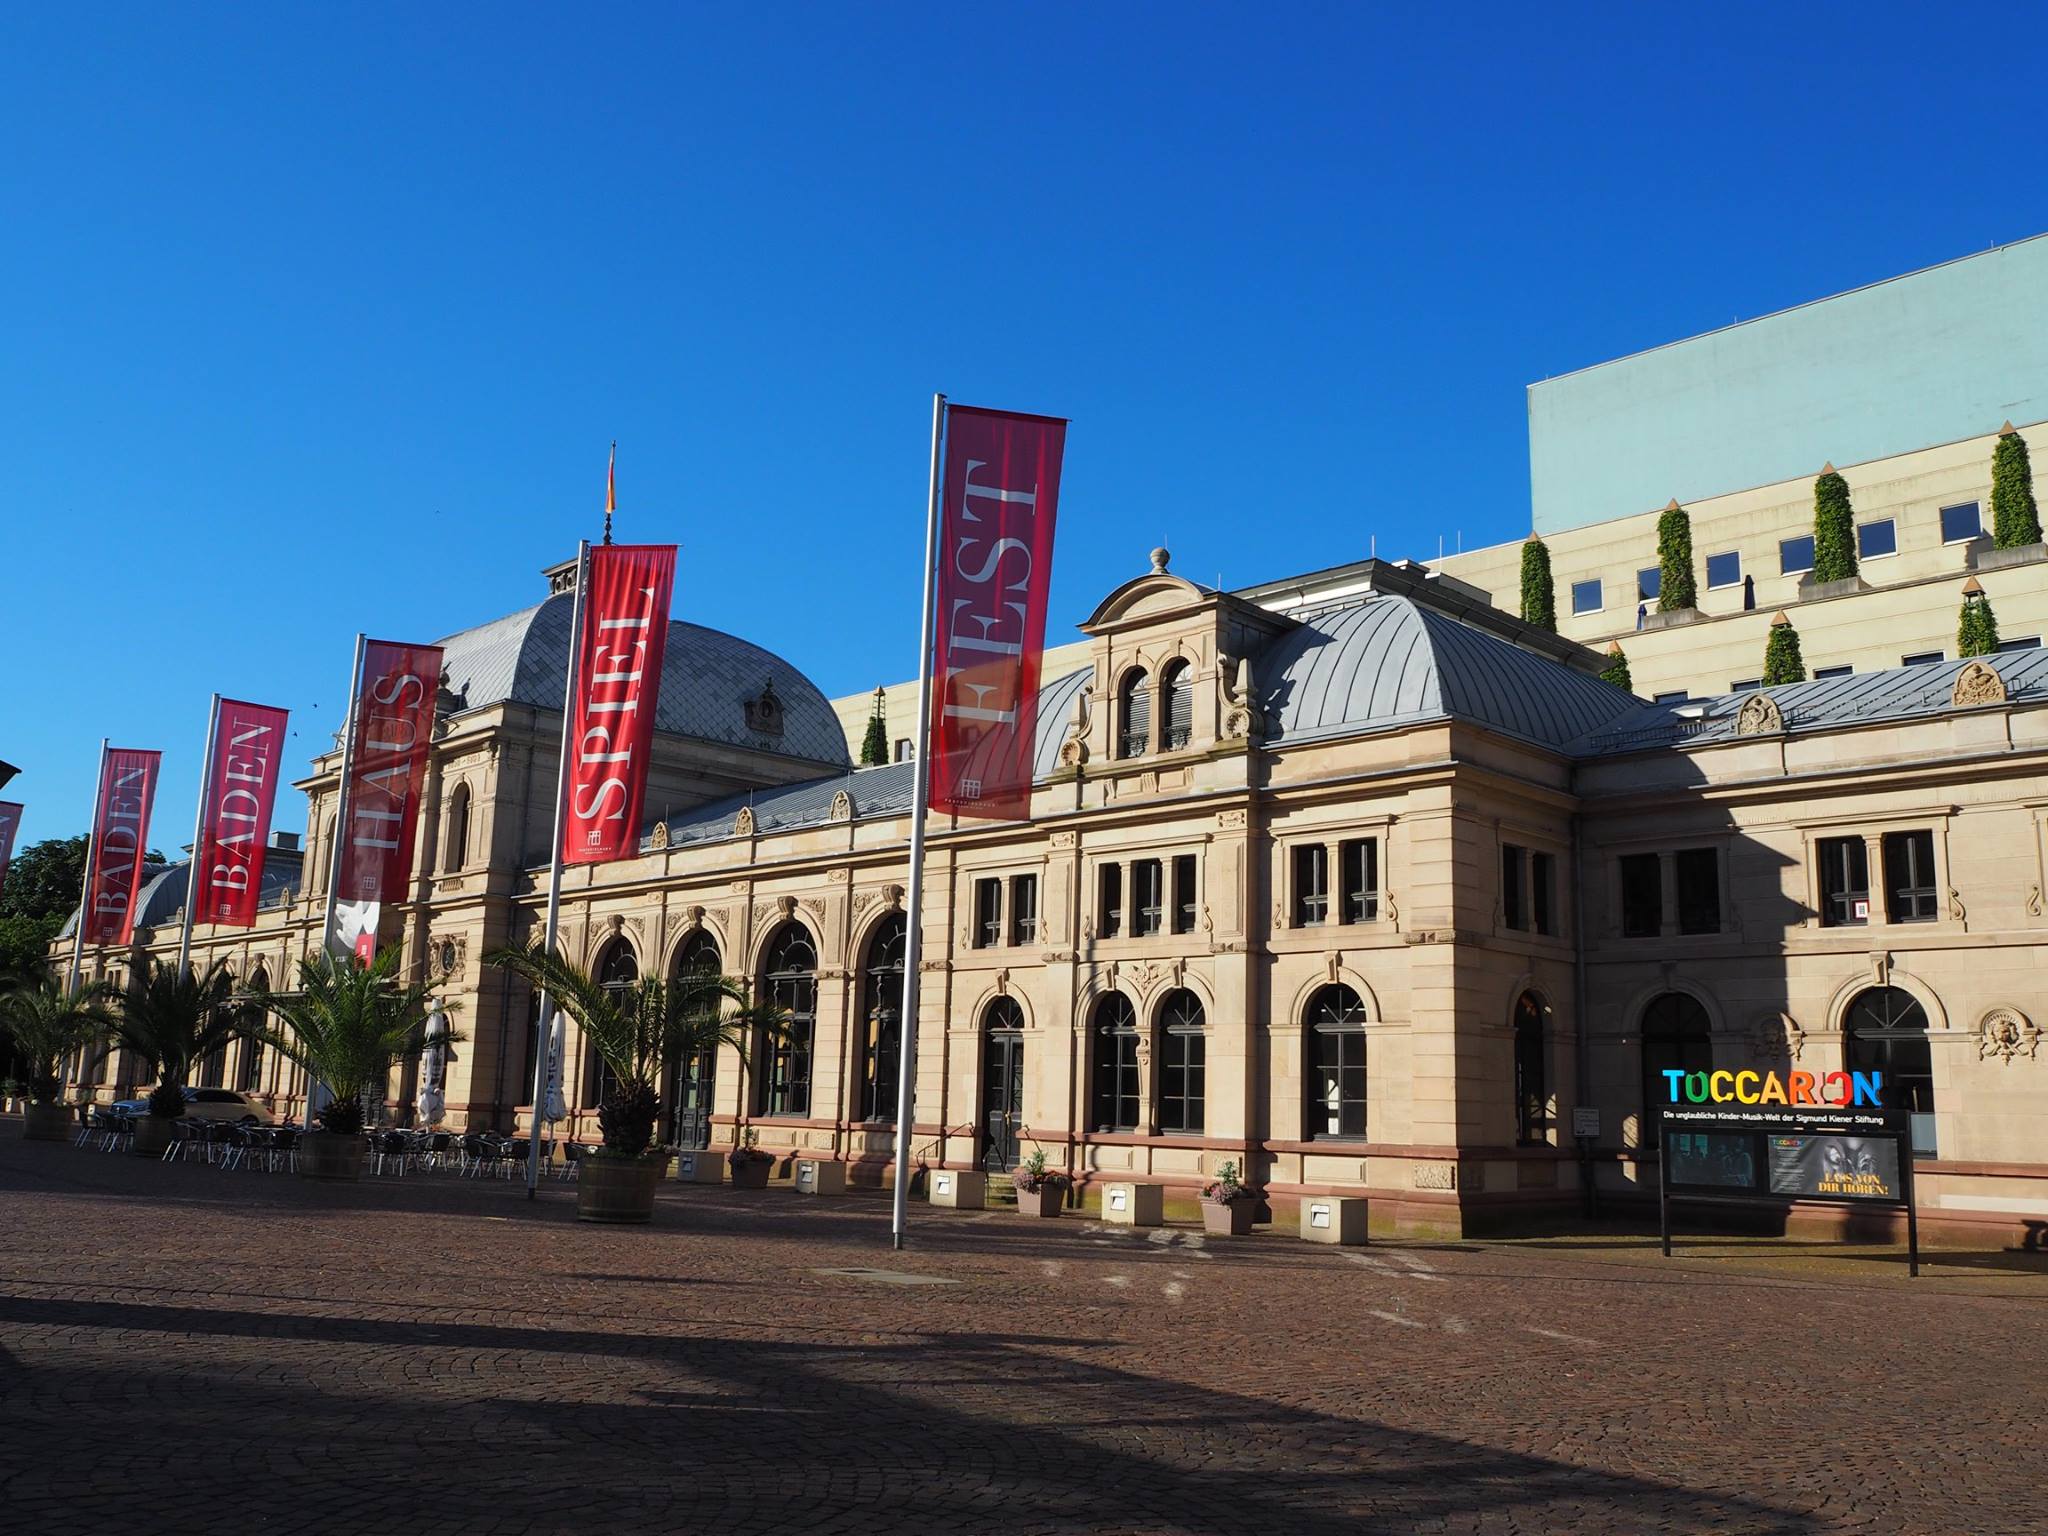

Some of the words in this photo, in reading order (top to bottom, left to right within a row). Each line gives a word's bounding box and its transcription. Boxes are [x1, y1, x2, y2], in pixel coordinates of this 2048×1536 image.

[941, 459, 1038, 735] FEST
[352, 674, 424, 856] HAUS
[575, 587, 655, 820] SPIEL
[94, 766, 149, 916] BADEN
[211, 716, 273, 895] BADEN
[1662, 1069, 1883, 1107] TOCCARION
[1663, 1110, 1675, 1119] Die
[1676, 1111, 1717, 1121] unglaubliche
[1718, 1112, 1781, 1122] Kinder-Musik-Welt
[1782, 1113, 1794, 1122] der
[1796, 1114, 1828, 1124] Sigmund
[1829, 1115, 1853, 1123] Kiener
[1855, 1115, 1884, 1125] Stiftung
[1818, 1182, 1840, 1192] DIR
